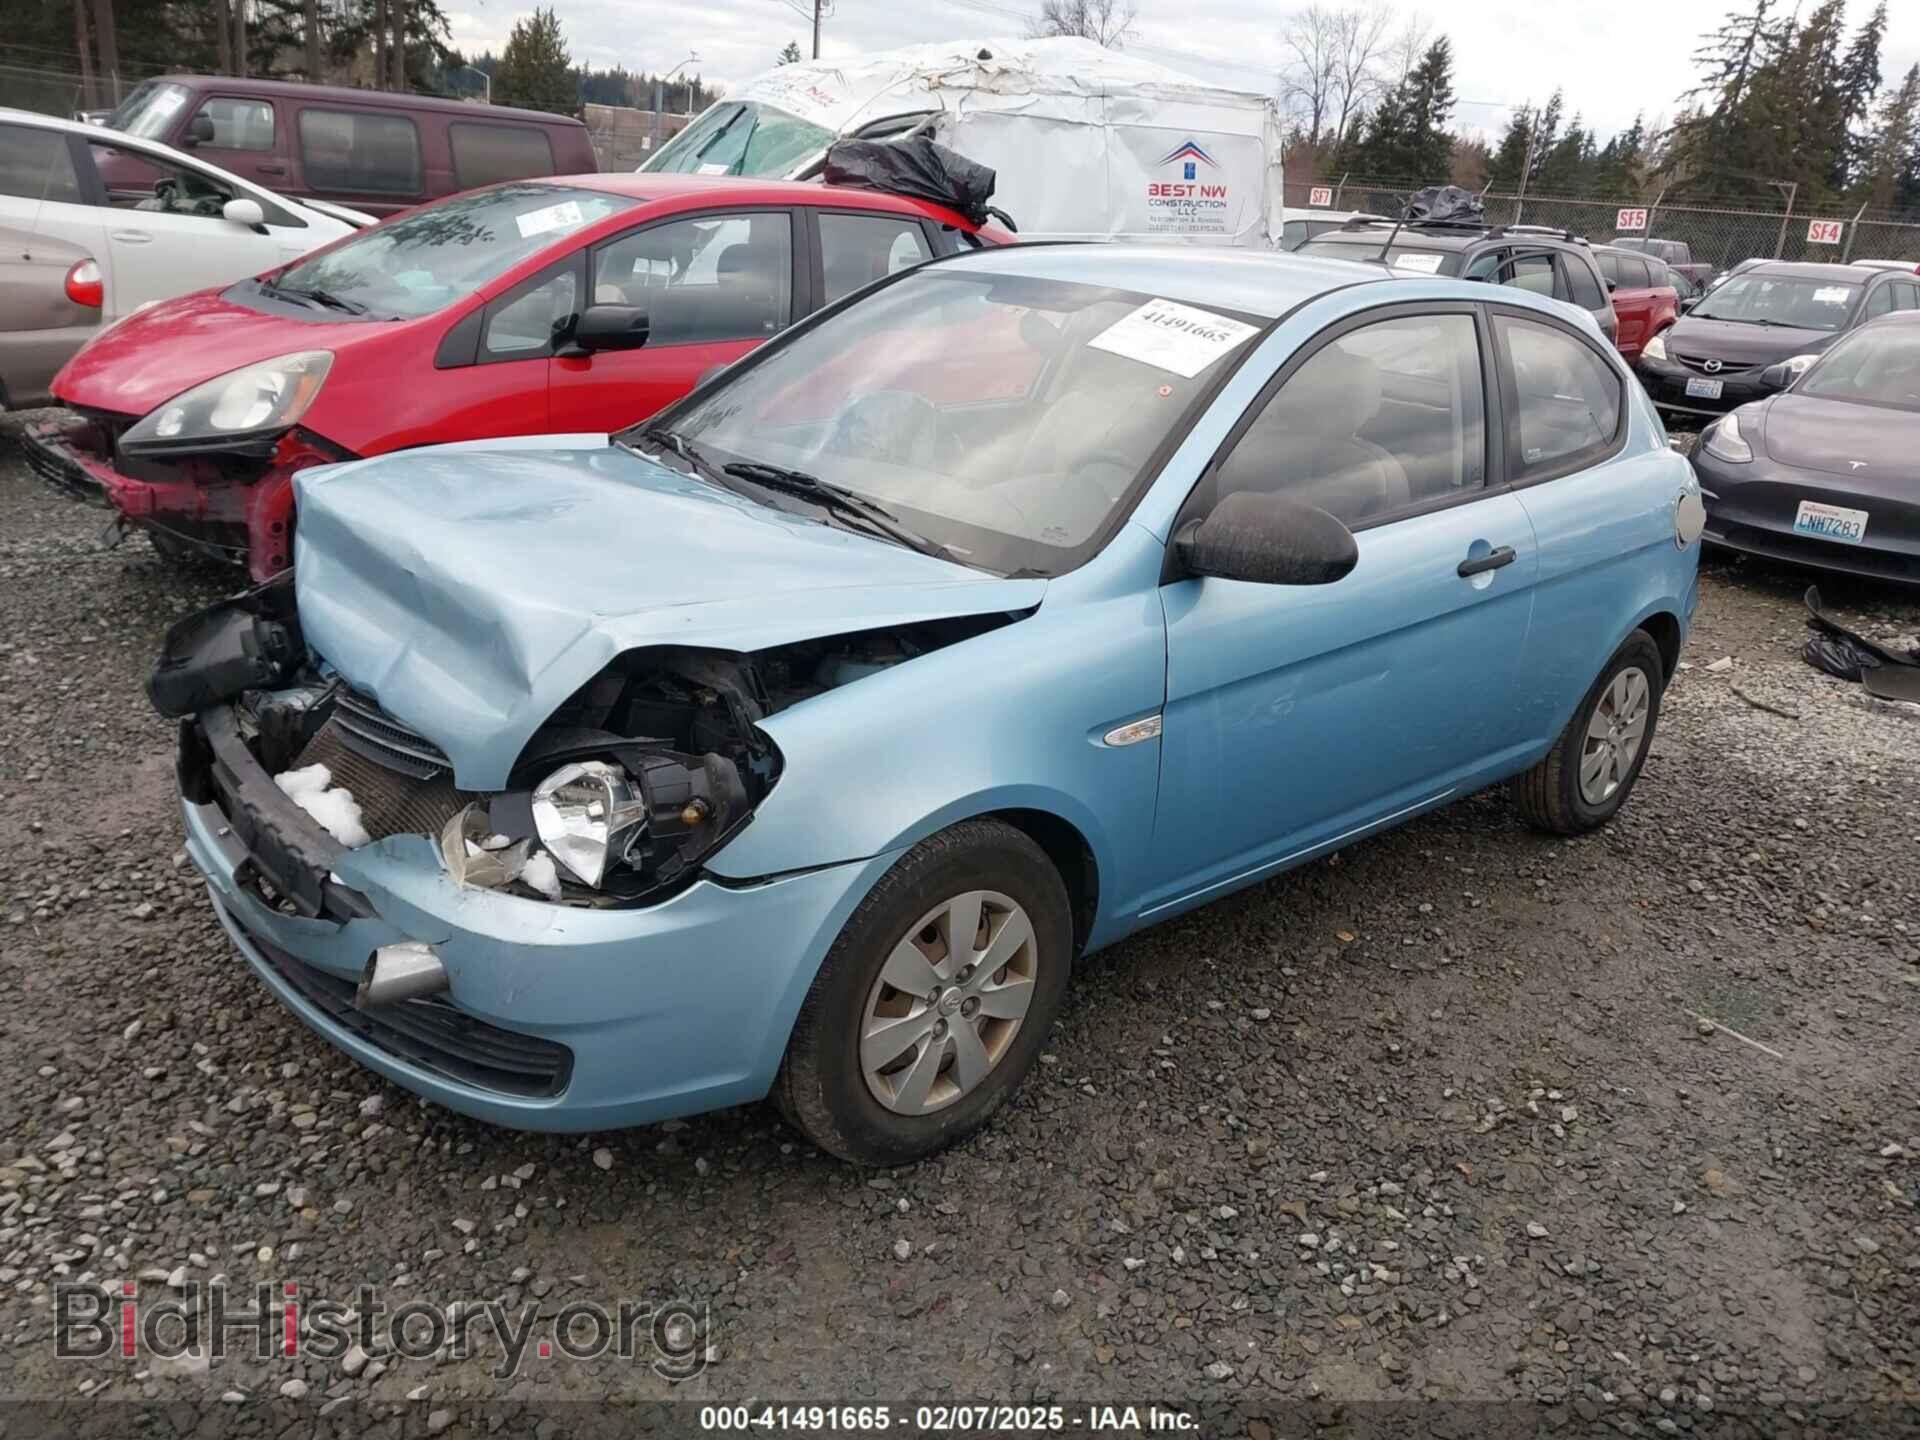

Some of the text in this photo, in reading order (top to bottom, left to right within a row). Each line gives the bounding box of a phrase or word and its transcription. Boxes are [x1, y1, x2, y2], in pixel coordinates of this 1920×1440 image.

[1148, 184, 1226, 197] BEST NW
[1148, 199, 1227, 208] CONSTRUCTION
[1177, 207, 1197, 216] LLC
[1620, 211, 1644, 227] SF5
[1810, 223, 1838, 241] SF4
[1140, 310, 1232, 342] 41491665
[1799, 512, 1860, 538] CNH7283
